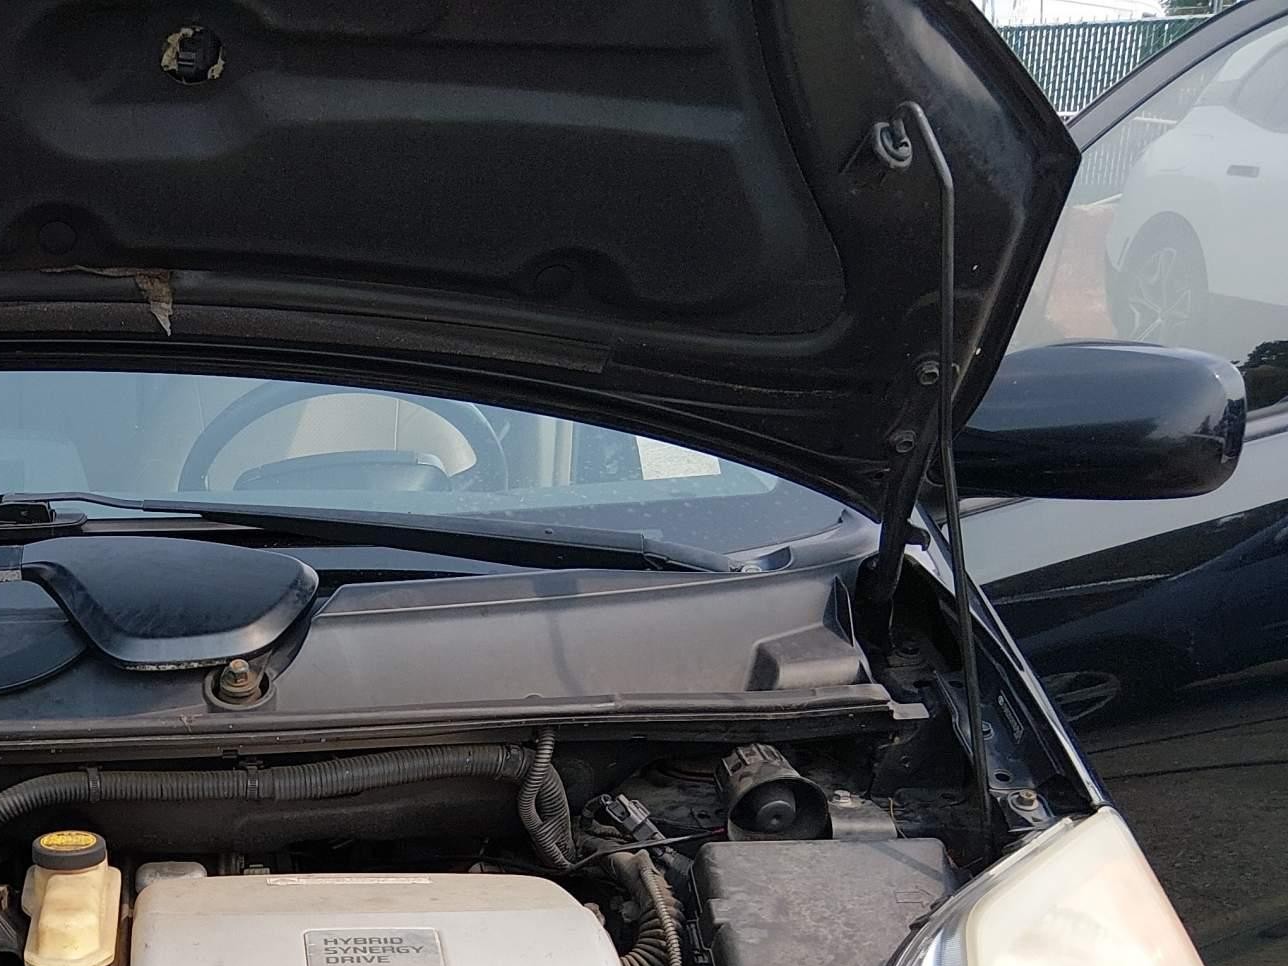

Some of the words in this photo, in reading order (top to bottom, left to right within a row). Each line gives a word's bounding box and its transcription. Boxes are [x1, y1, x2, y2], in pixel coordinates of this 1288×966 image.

[323, 937, 404, 946] HYBRID
[323, 945, 425, 955] SYNERGY
[325, 955, 392, 965] DRIVE
